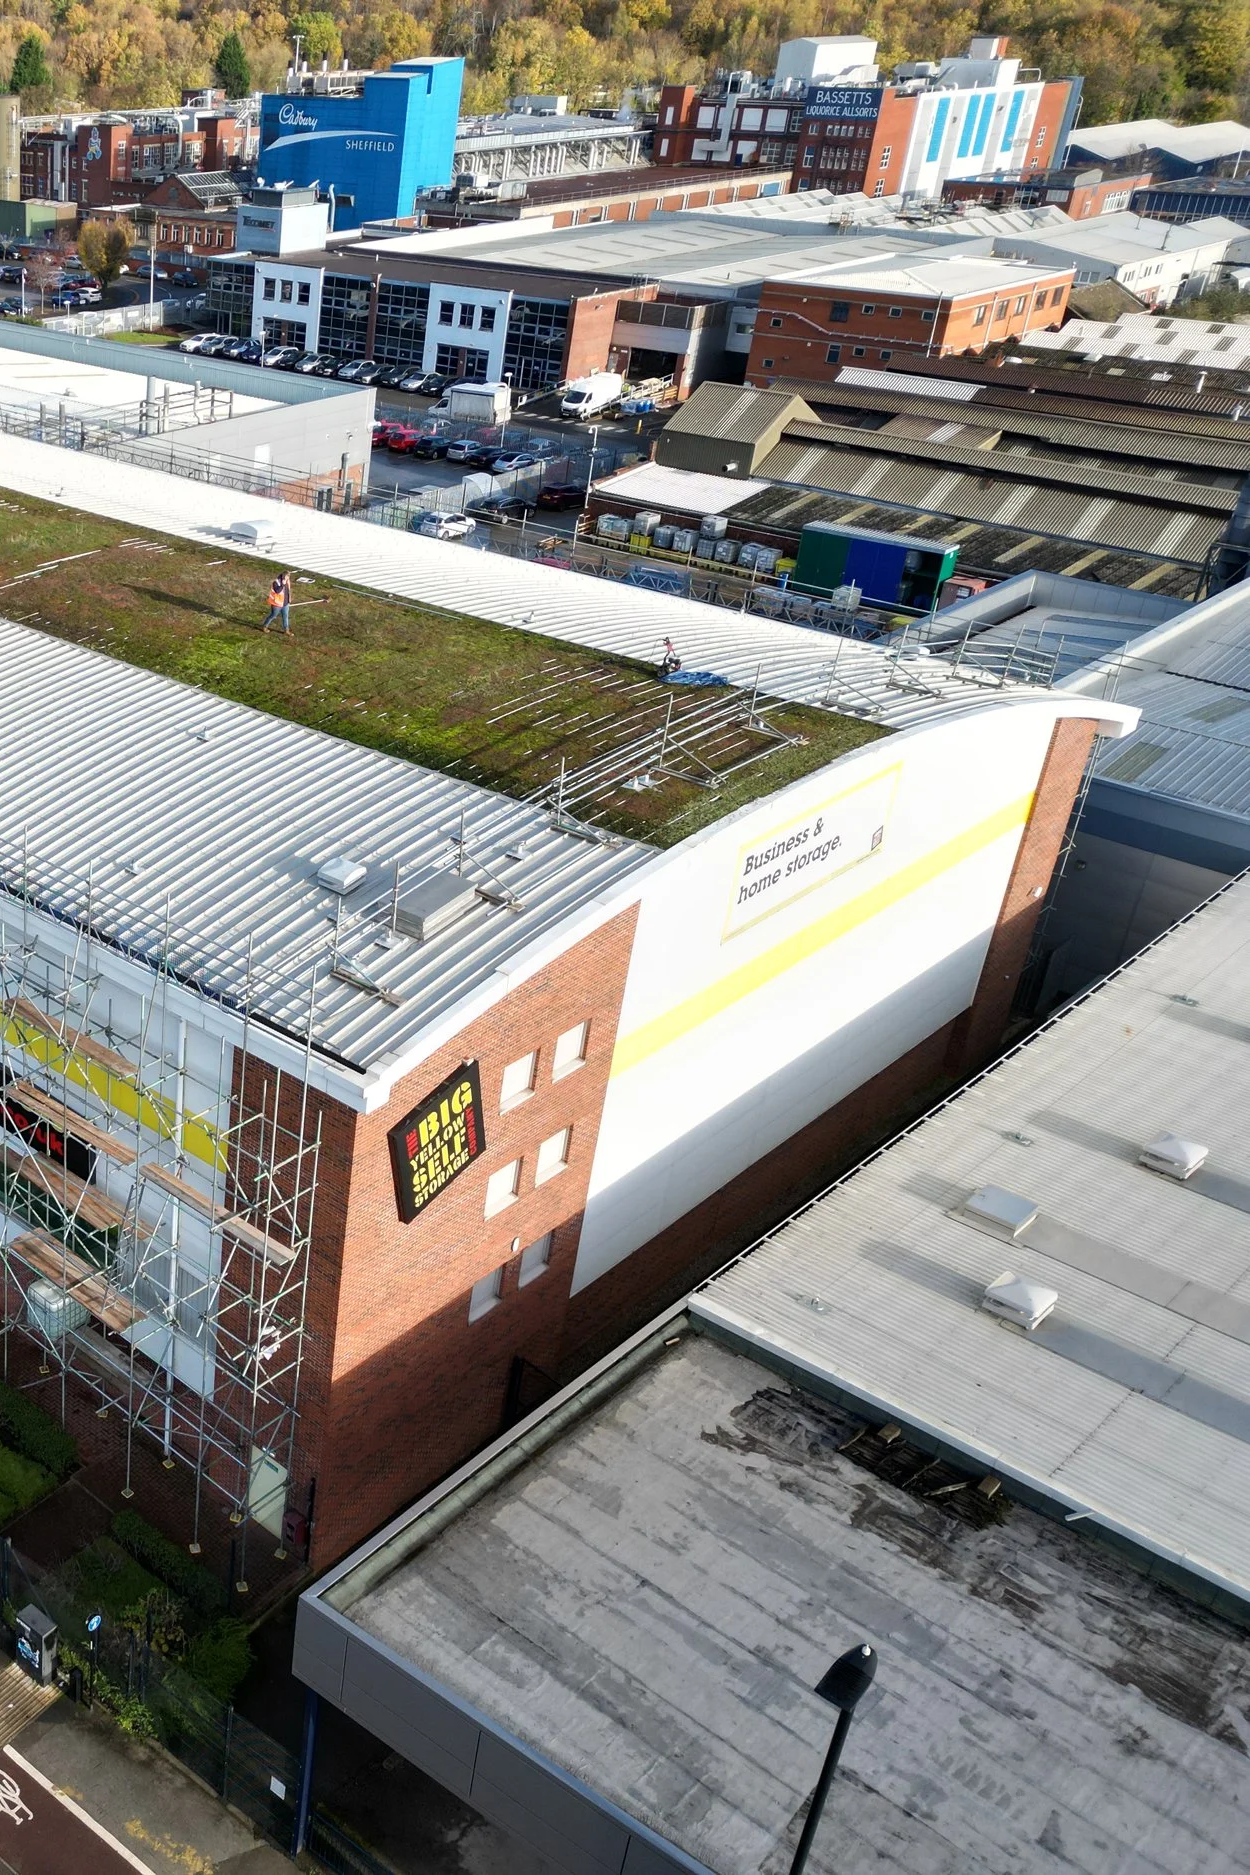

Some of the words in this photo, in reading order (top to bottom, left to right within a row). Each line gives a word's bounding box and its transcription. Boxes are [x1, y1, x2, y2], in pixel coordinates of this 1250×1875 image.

[278, 103, 318, 131] Cadbury
[806, 105, 841, 117] LIQUORICE
[841, 106, 878, 118] ALLSORTS
[816, 91, 872, 105] BASSETTS
[345, 139, 395, 152] SHEFFIELD
[737, 868, 781, 904] home
[785, 834, 843, 878] storage.
[743, 827, 809, 876] Business
[813, 817, 824, 836] &
[405, 1128, 419, 1160] THE
[409, 1112, 465, 1172] YELLOW
[418, 1081, 473, 1148] BIG
[412, 1126, 466, 1193] SELF
[414, 1147, 470, 1208] STORAGE
